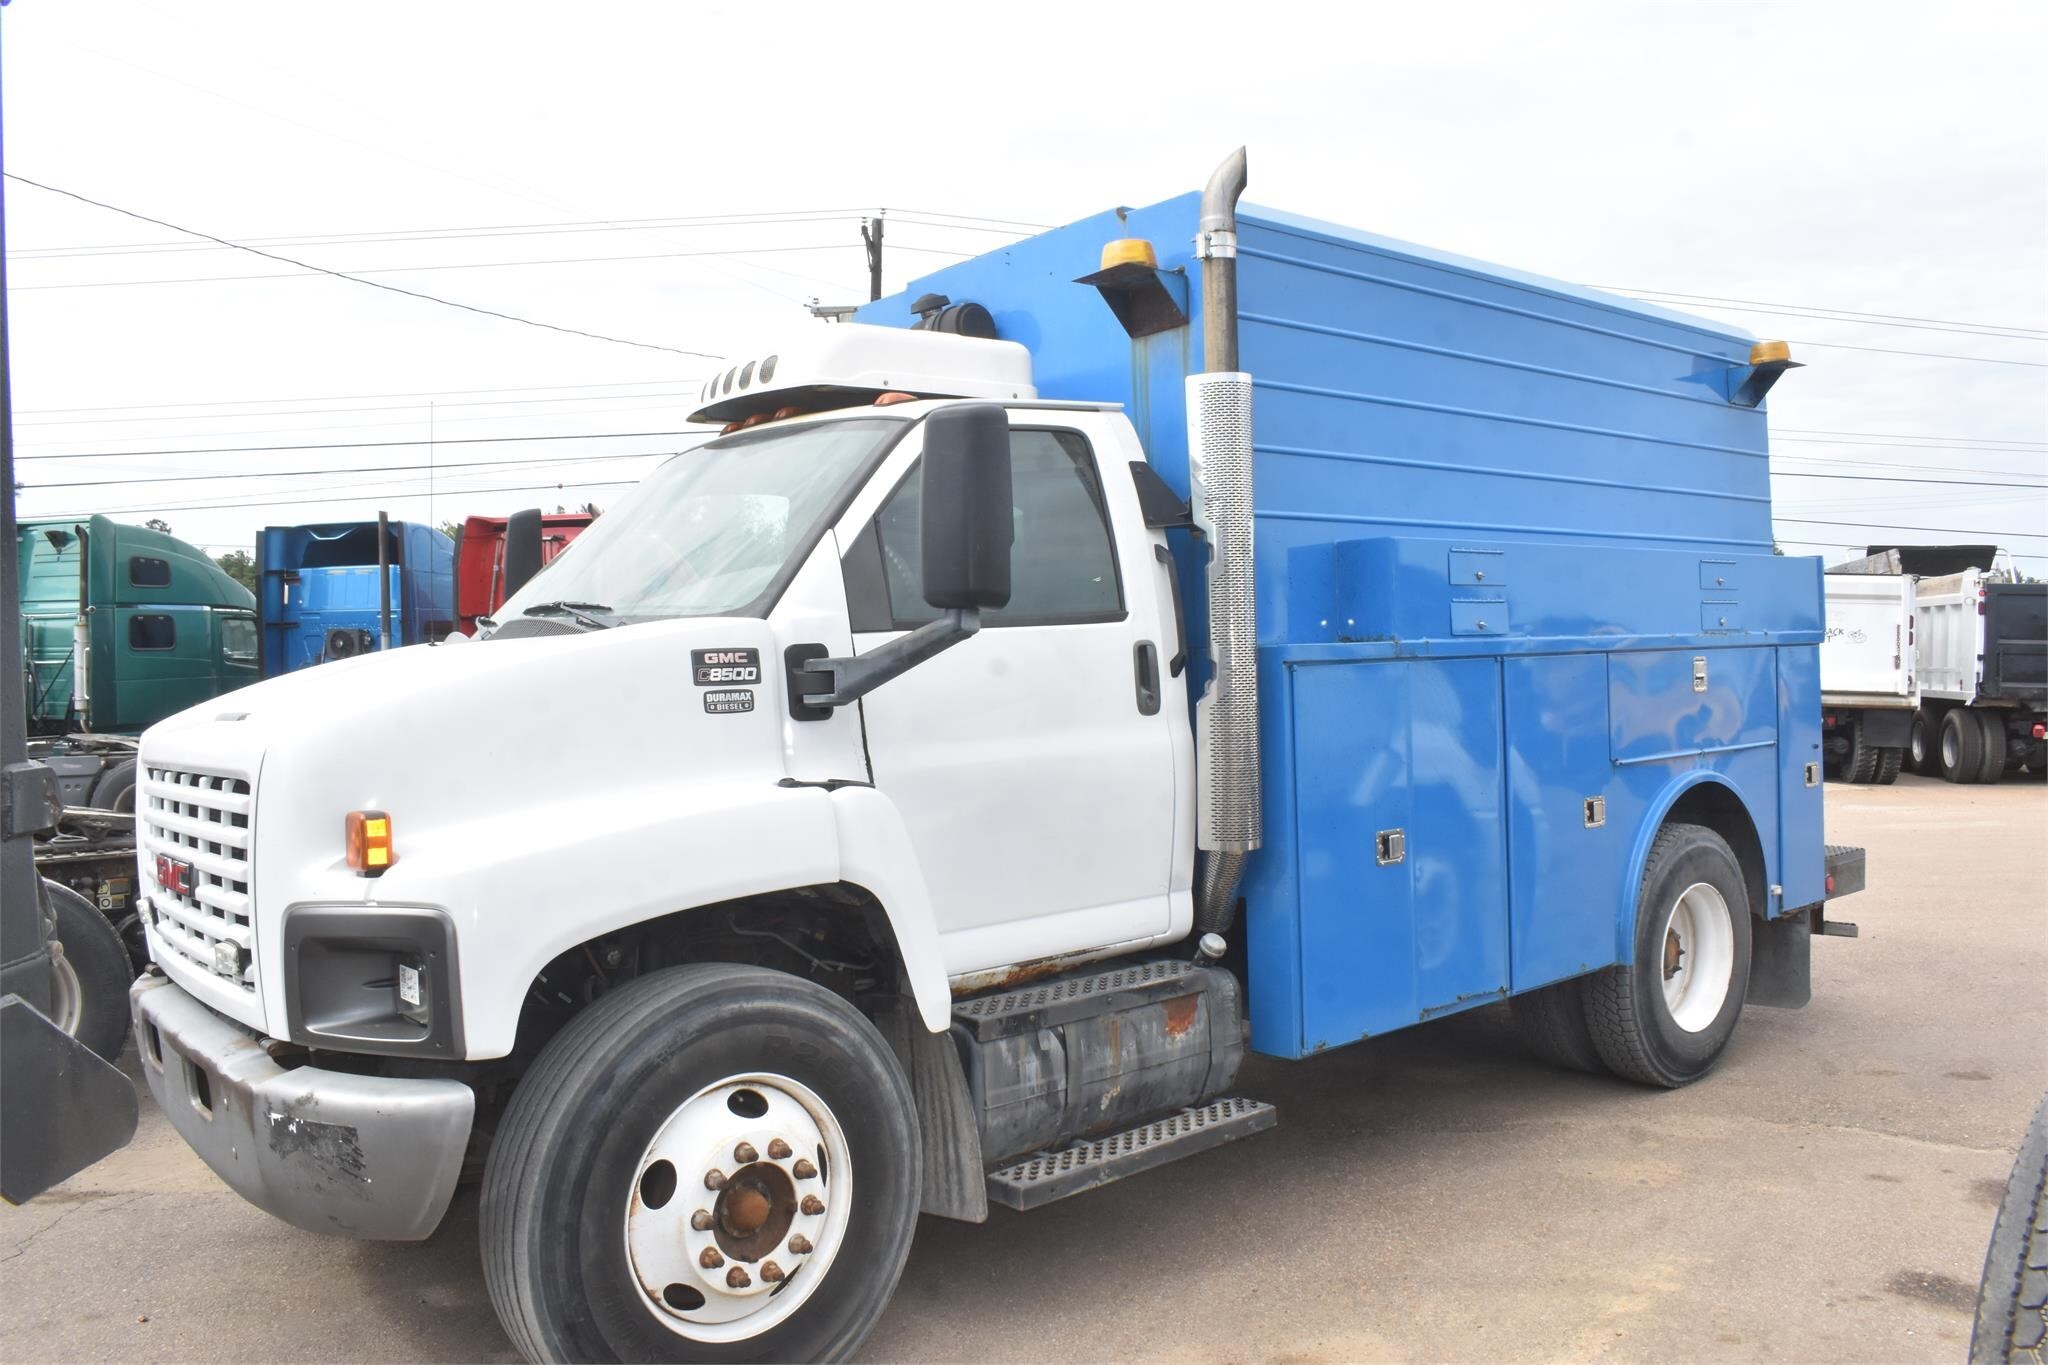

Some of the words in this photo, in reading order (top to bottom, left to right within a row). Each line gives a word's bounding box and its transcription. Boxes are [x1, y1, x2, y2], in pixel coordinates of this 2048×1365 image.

[704, 652, 748, 664] GMC
[697, 667, 757, 682] C8500
[706, 691, 752, 702] DURAMAX
[717, 702, 744, 711] DIESEL
[156, 855, 190, 896] GMC
